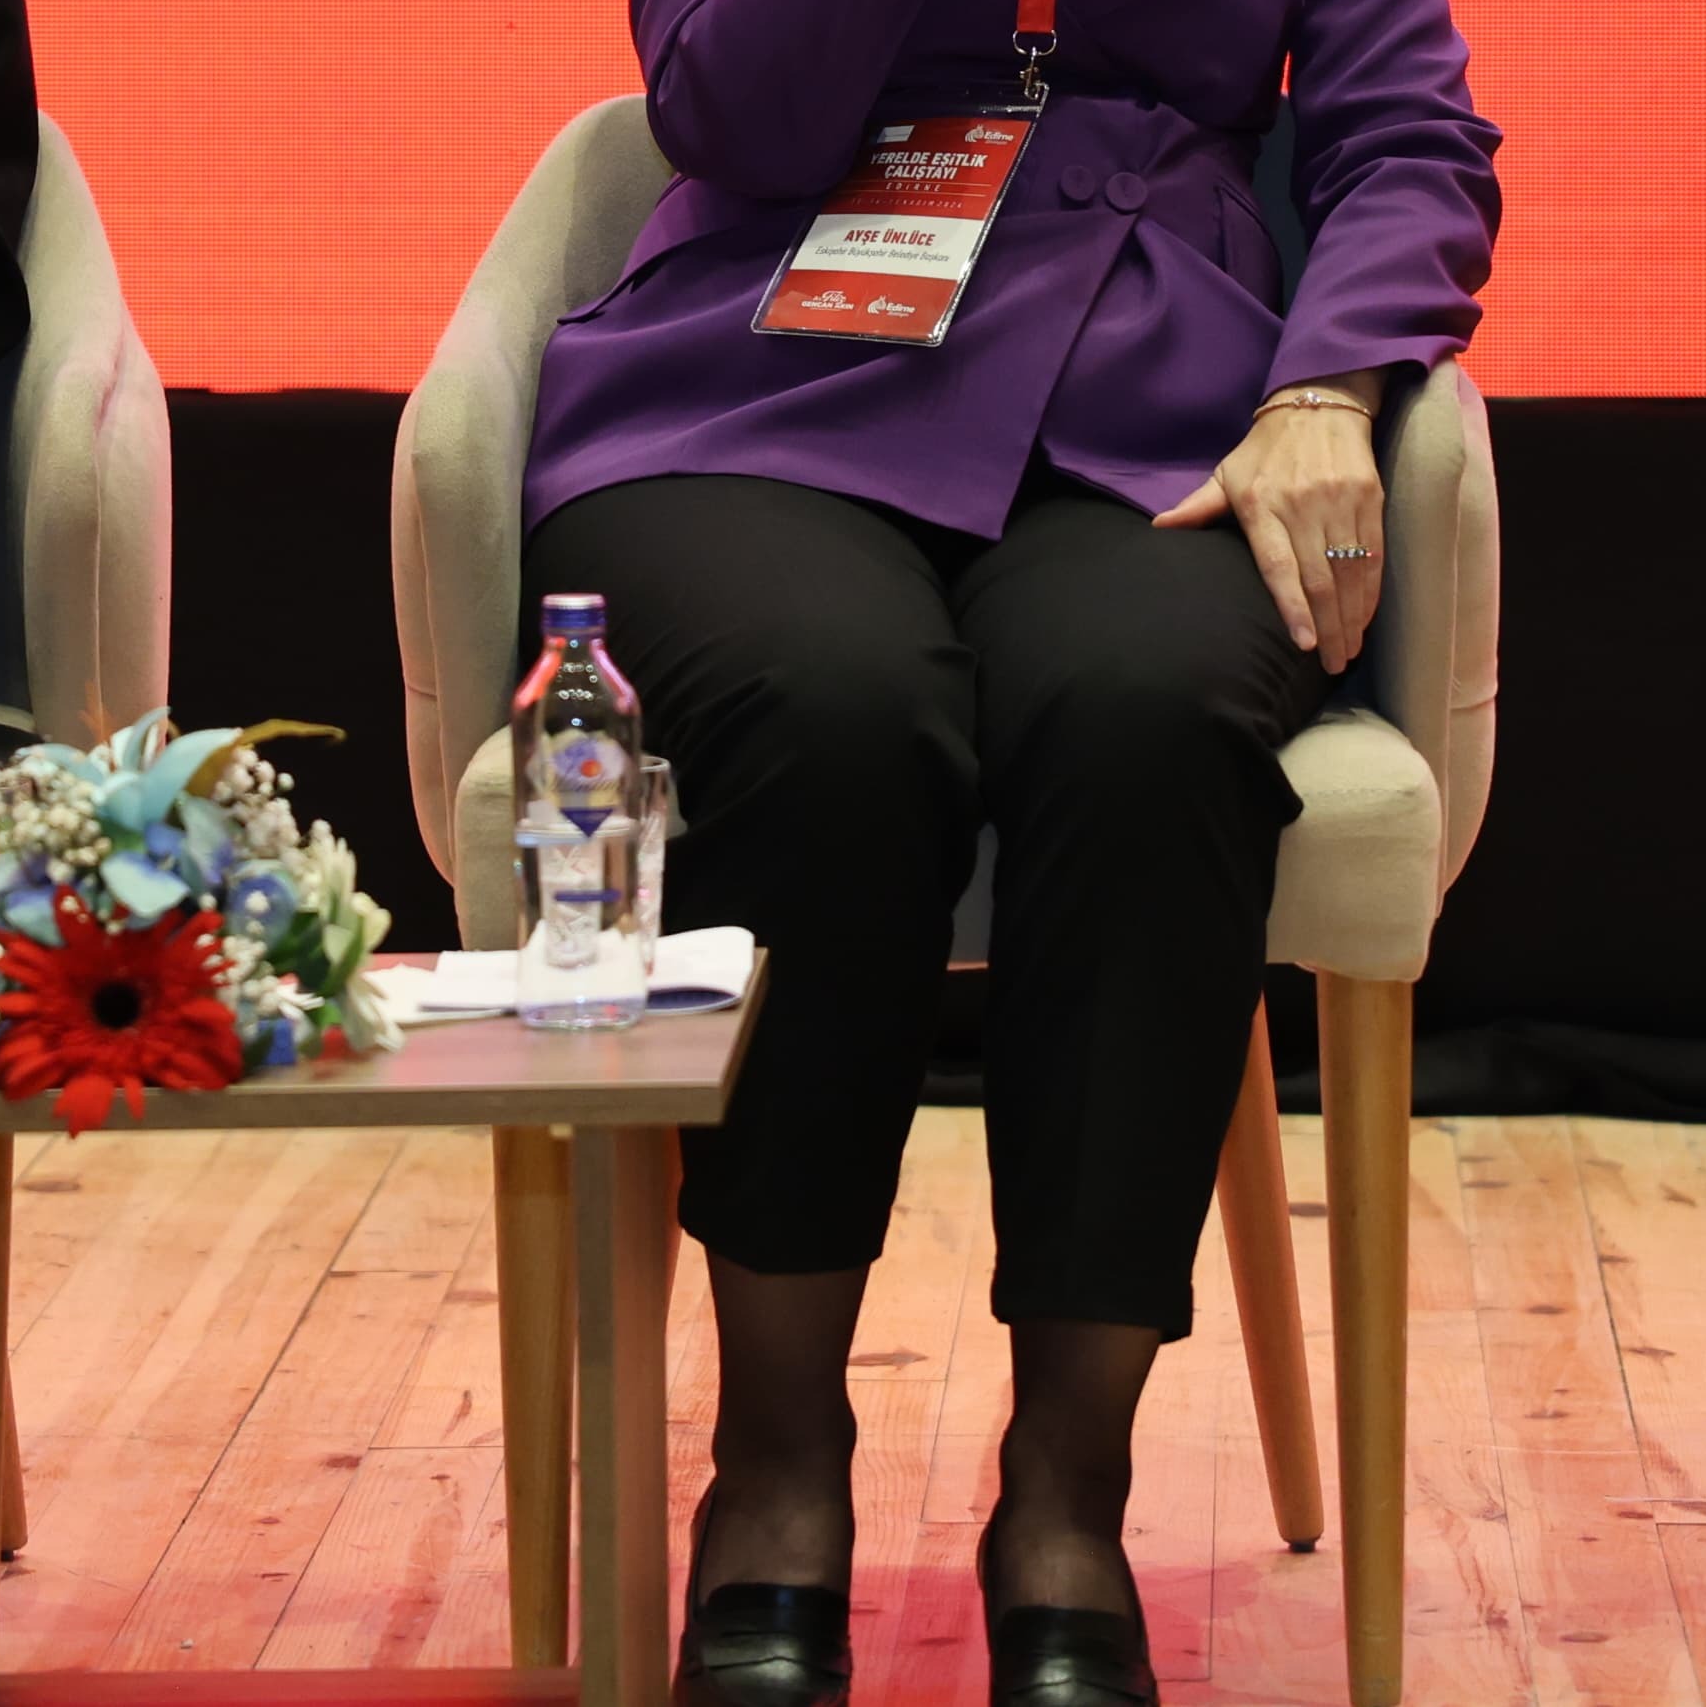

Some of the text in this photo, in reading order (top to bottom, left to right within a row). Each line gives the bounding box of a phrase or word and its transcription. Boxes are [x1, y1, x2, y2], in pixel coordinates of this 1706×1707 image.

[983, 130, 1014, 142] Edirne
[870, 151, 931, 165] YERELDE
[884, 165, 958, 180] ÇALIŞTAYI
[844, 228, 936, 247] AYŞE ÜNLÜCE
[886, 302, 916, 314] Edirne
